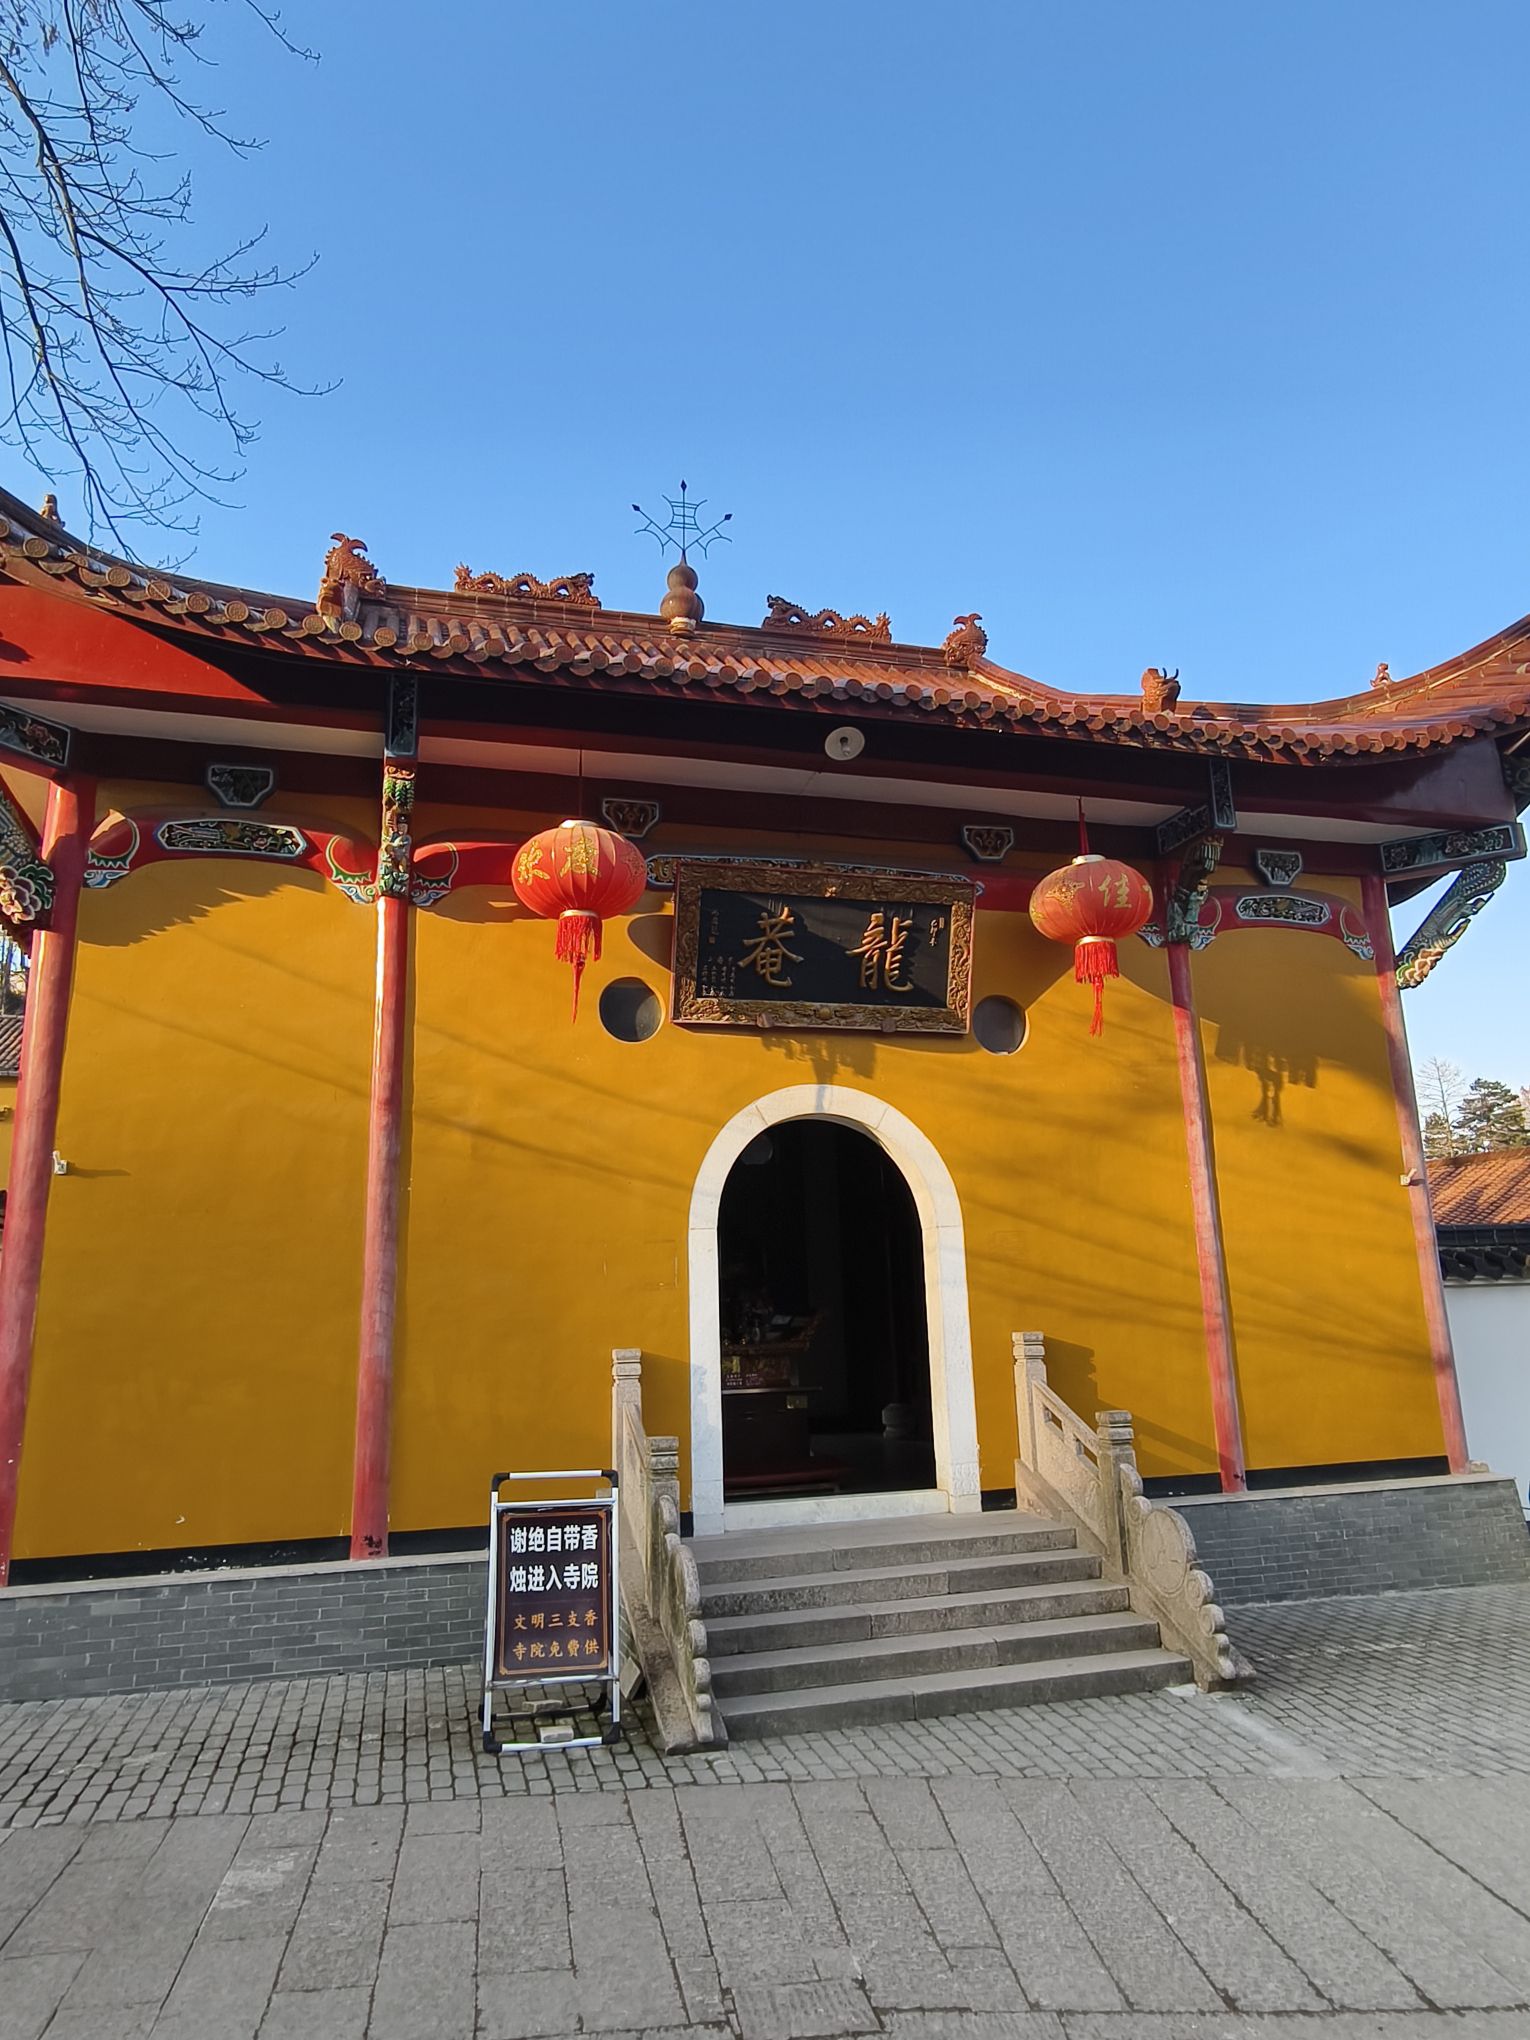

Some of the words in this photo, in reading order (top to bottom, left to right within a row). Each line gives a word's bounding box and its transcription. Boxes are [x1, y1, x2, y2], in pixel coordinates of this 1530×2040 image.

[510, 1524, 598, 1553] 谢绝自带香
[510, 1562, 598, 1592] 烛进入寺院
[513, 1609, 598, 1630] 文明三支香
